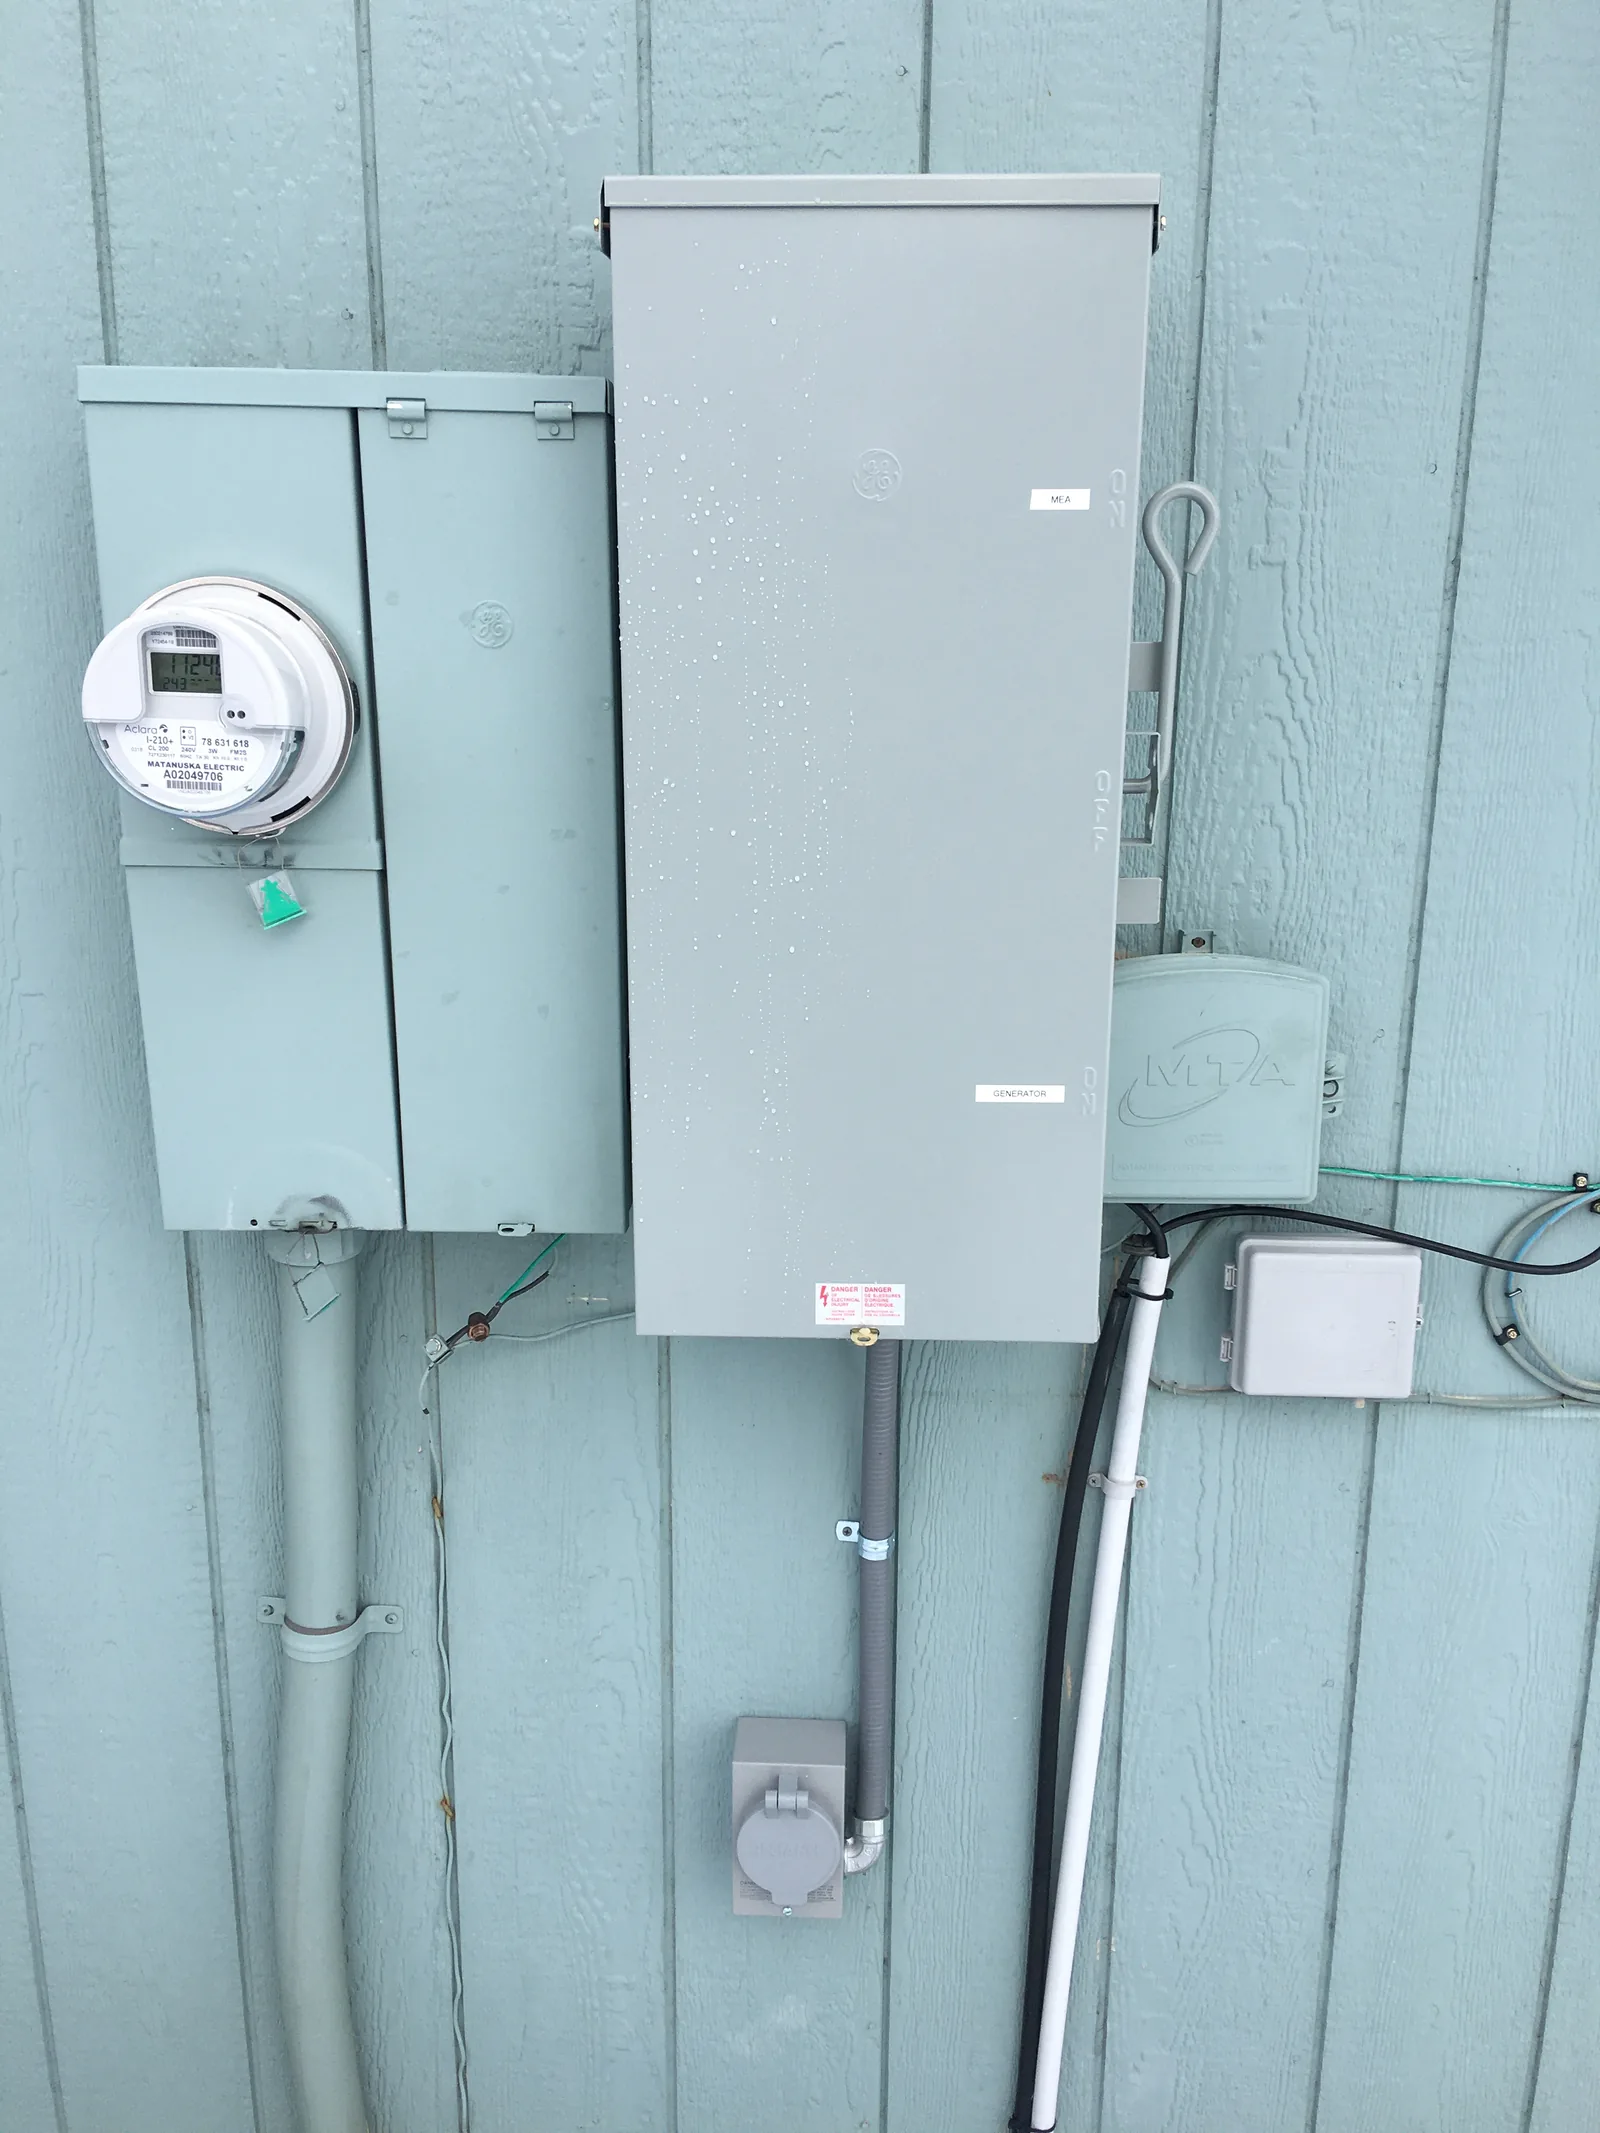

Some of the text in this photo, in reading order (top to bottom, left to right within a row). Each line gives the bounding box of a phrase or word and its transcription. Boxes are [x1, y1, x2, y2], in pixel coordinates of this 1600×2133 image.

[1051, 496, 1071, 504] MEA
[163, 677, 187, 691] 243
[124, 724, 158, 735] Aclara
[201, 738, 250, 748] 78 631 618
[147, 761, 245, 772] MATANUSKA ELECTRIC
[163, 769, 223, 782] A02049706
[1146, 1054, 1296, 1087] MTA
[993, 1089, 1047, 1098] GENERATOR
